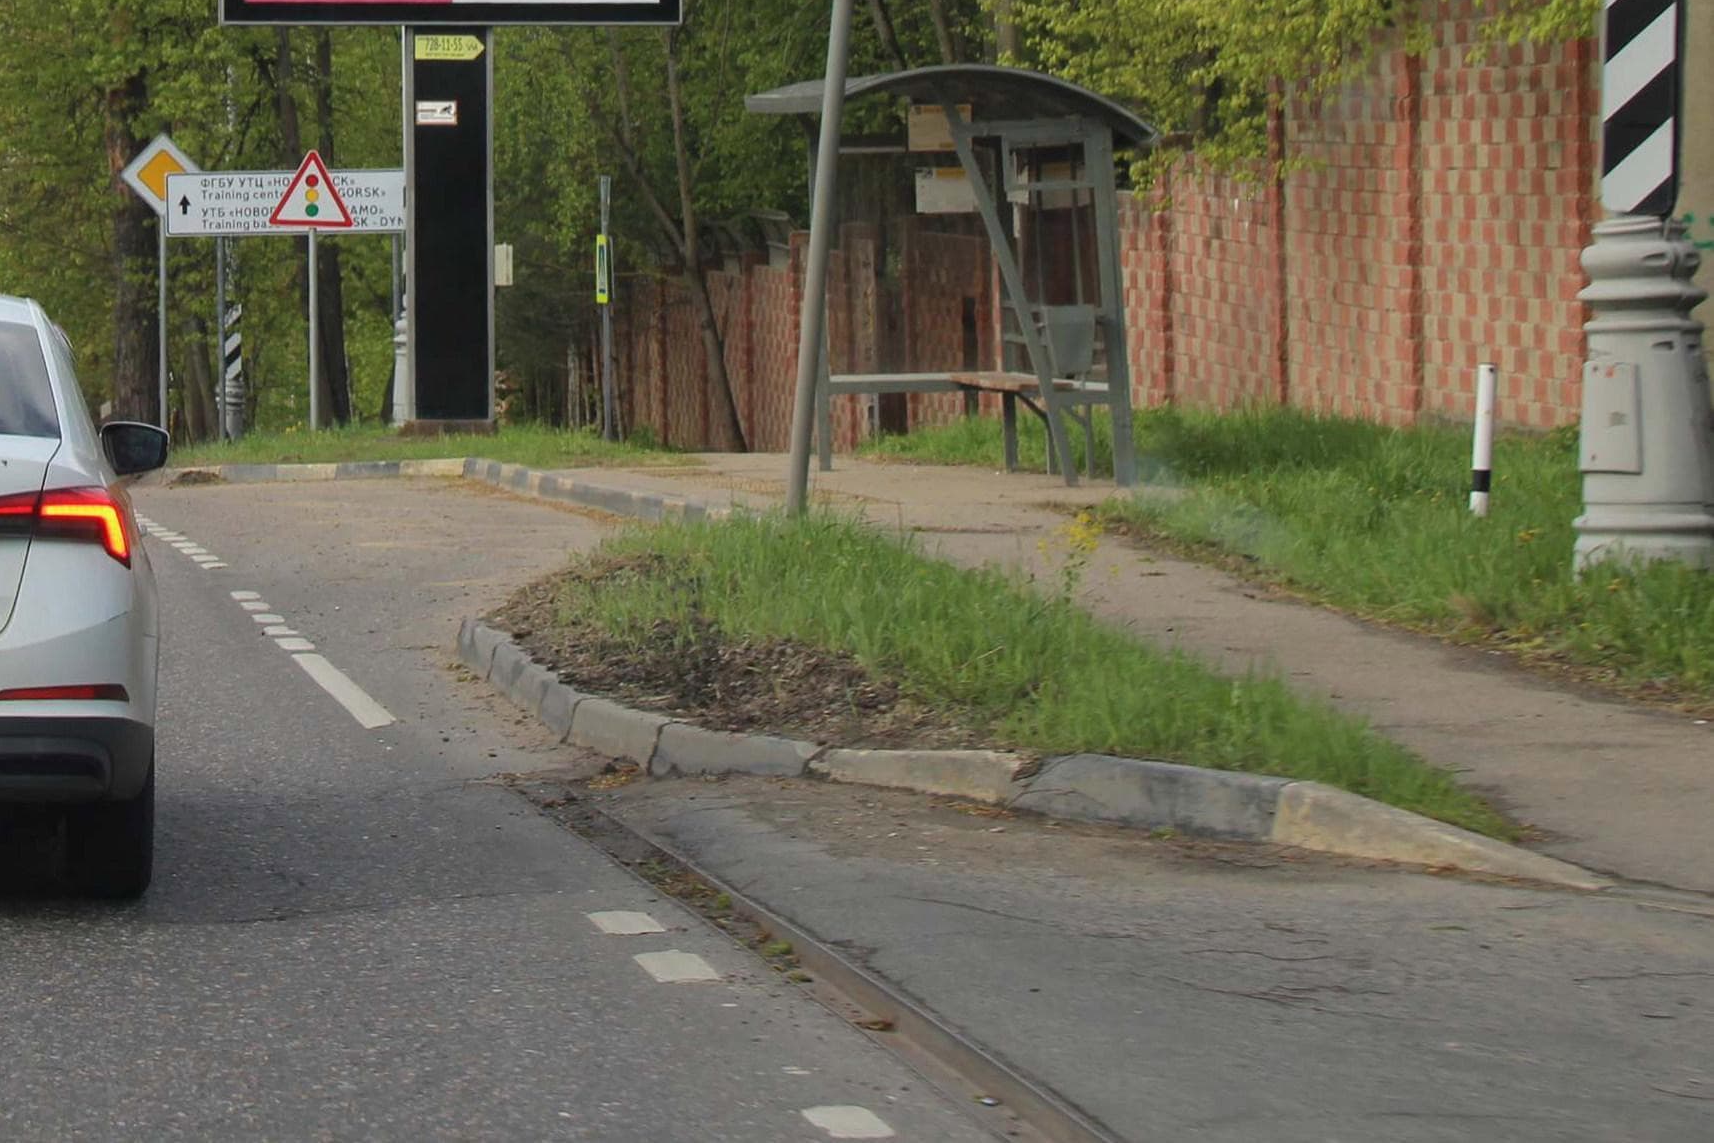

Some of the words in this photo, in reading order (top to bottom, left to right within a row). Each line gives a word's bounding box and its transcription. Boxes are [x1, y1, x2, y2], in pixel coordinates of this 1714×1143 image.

[201, 178, 234, 188] ФГБУ
[238, 177, 264, 189] УТЦ
[202, 190, 249, 201] Training
[253, 190, 284, 199] cent
[338, 187, 386, 198] GORSK»
[202, 207, 226, 217] УТБ
[349, 205, 384, 215] АМО»
[202, 219, 250, 230] Training
